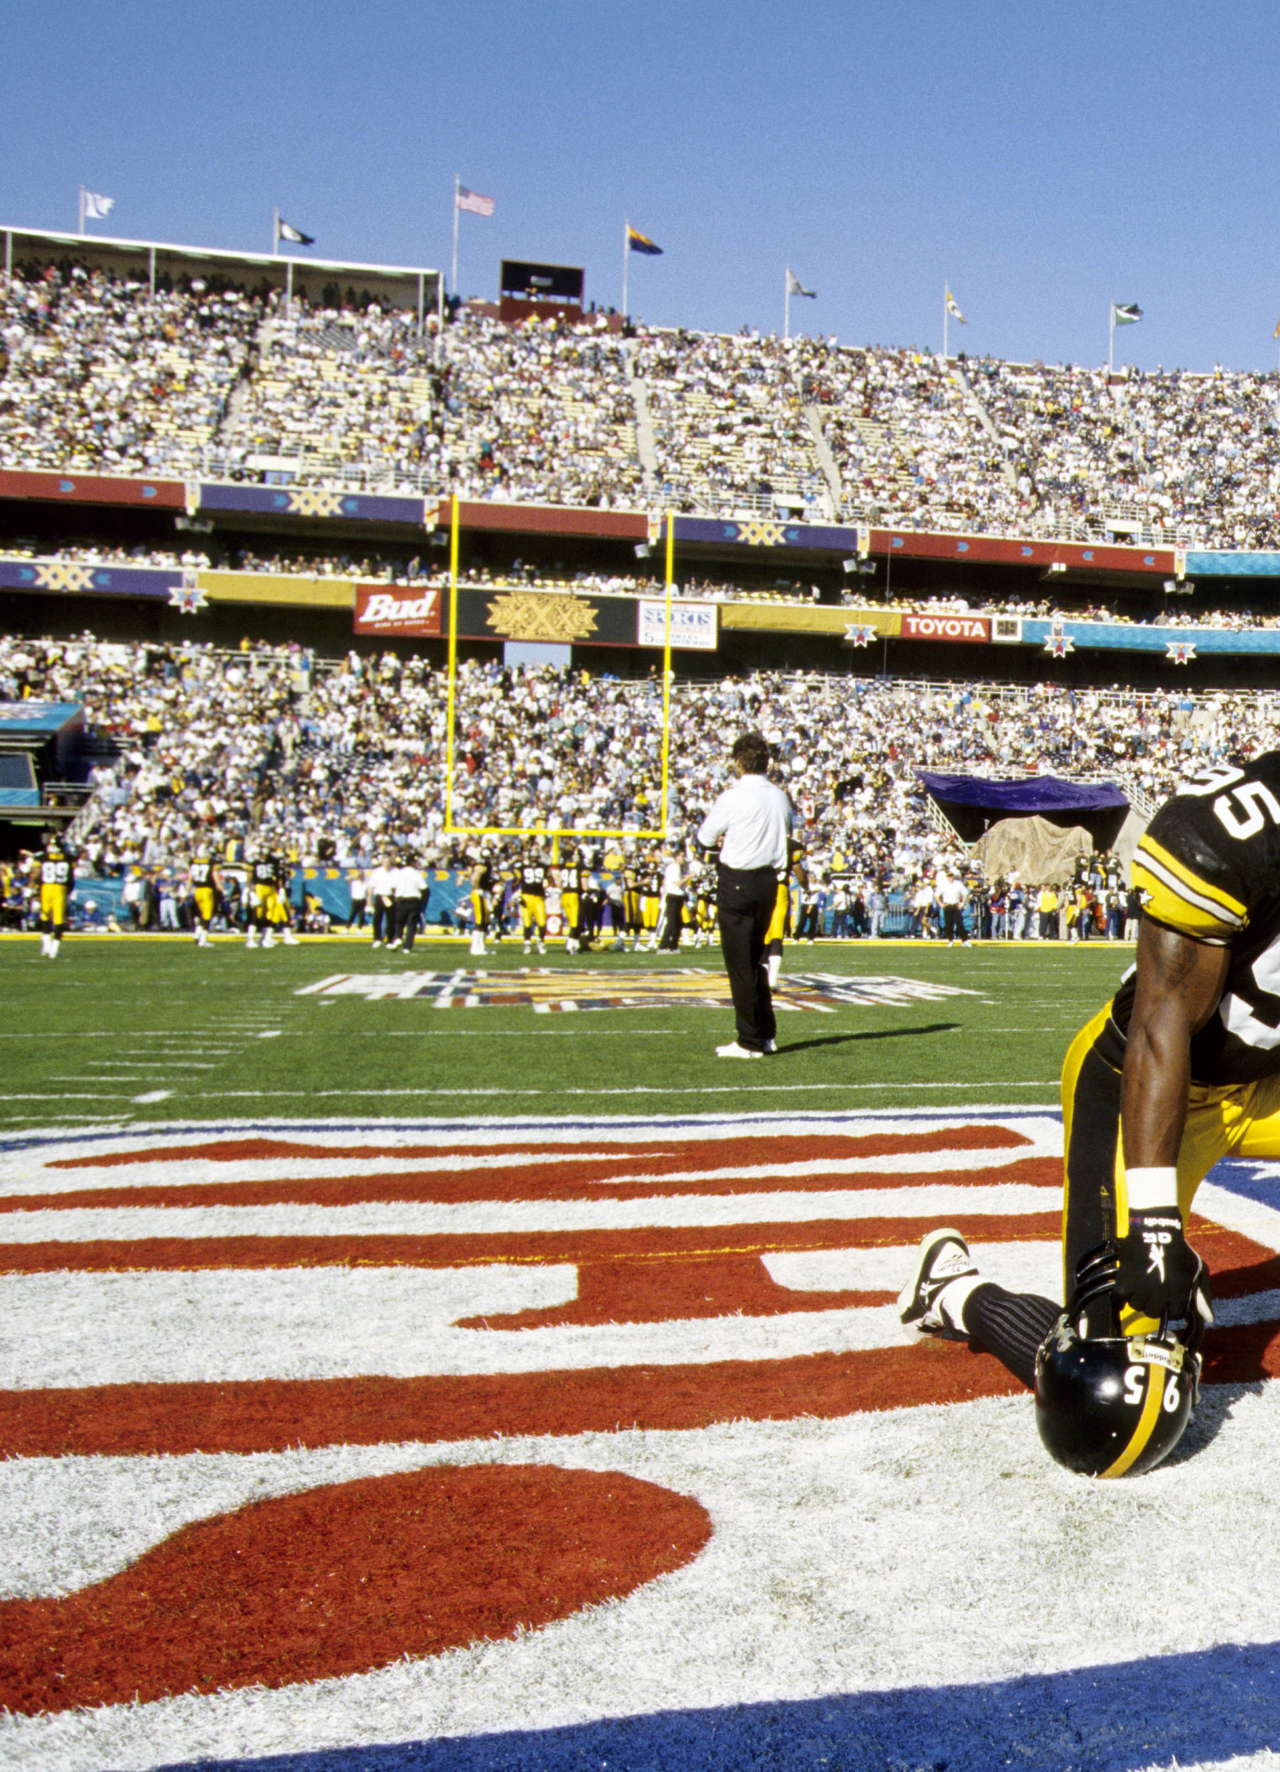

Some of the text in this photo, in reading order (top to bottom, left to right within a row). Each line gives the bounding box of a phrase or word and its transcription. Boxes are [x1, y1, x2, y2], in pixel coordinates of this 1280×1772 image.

[287, 490, 344, 516] XXX
[737, 521, 786, 546] XXX
[34, 564, 95, 591] XXX
[906, 617, 986, 637] TOYOTA
[42, 861, 69, 884] 89
[524, 868, 544, 884] 99
[1124, 1365, 1181, 1413] 95
